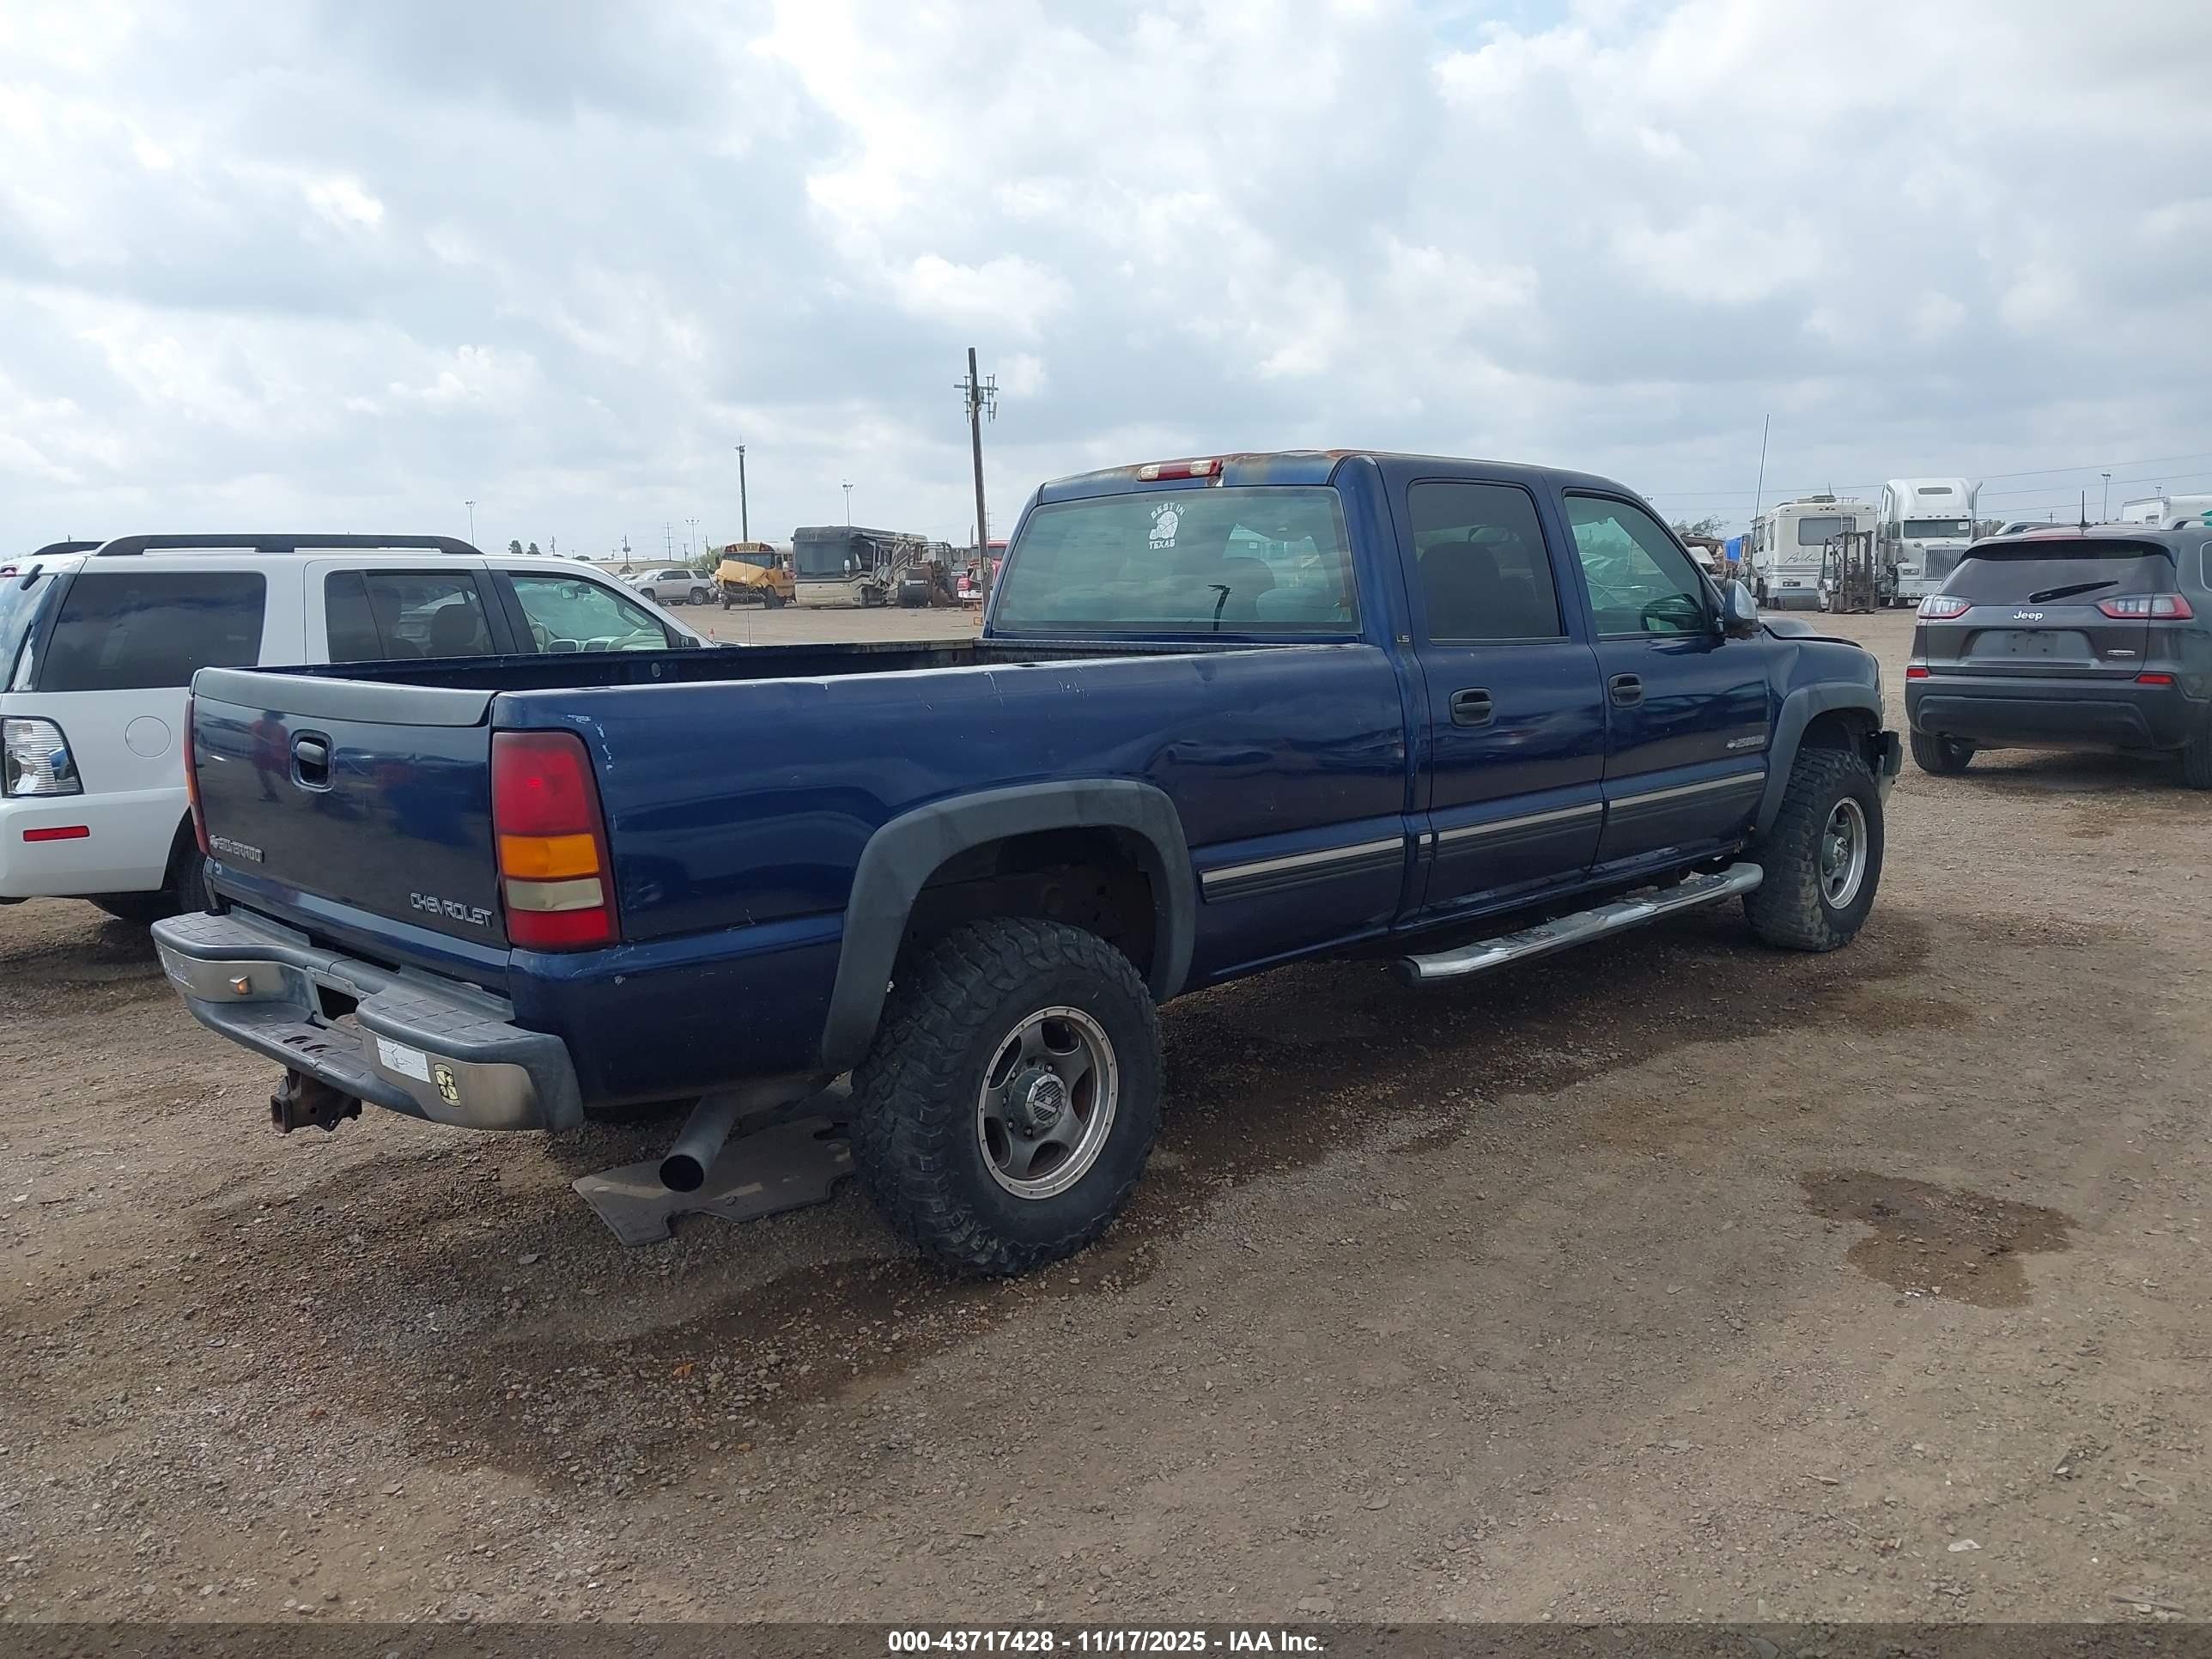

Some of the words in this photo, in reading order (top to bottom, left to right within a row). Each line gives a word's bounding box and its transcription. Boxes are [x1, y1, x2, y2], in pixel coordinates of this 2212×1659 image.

[1151, 502, 1175, 520] BEST
[1176, 504, 1186, 516] IN
[1149, 539, 1176, 550] TEXAS
[2013, 610, 2044, 622] Jeep
[410, 893, 492, 927] CHEVROLET
